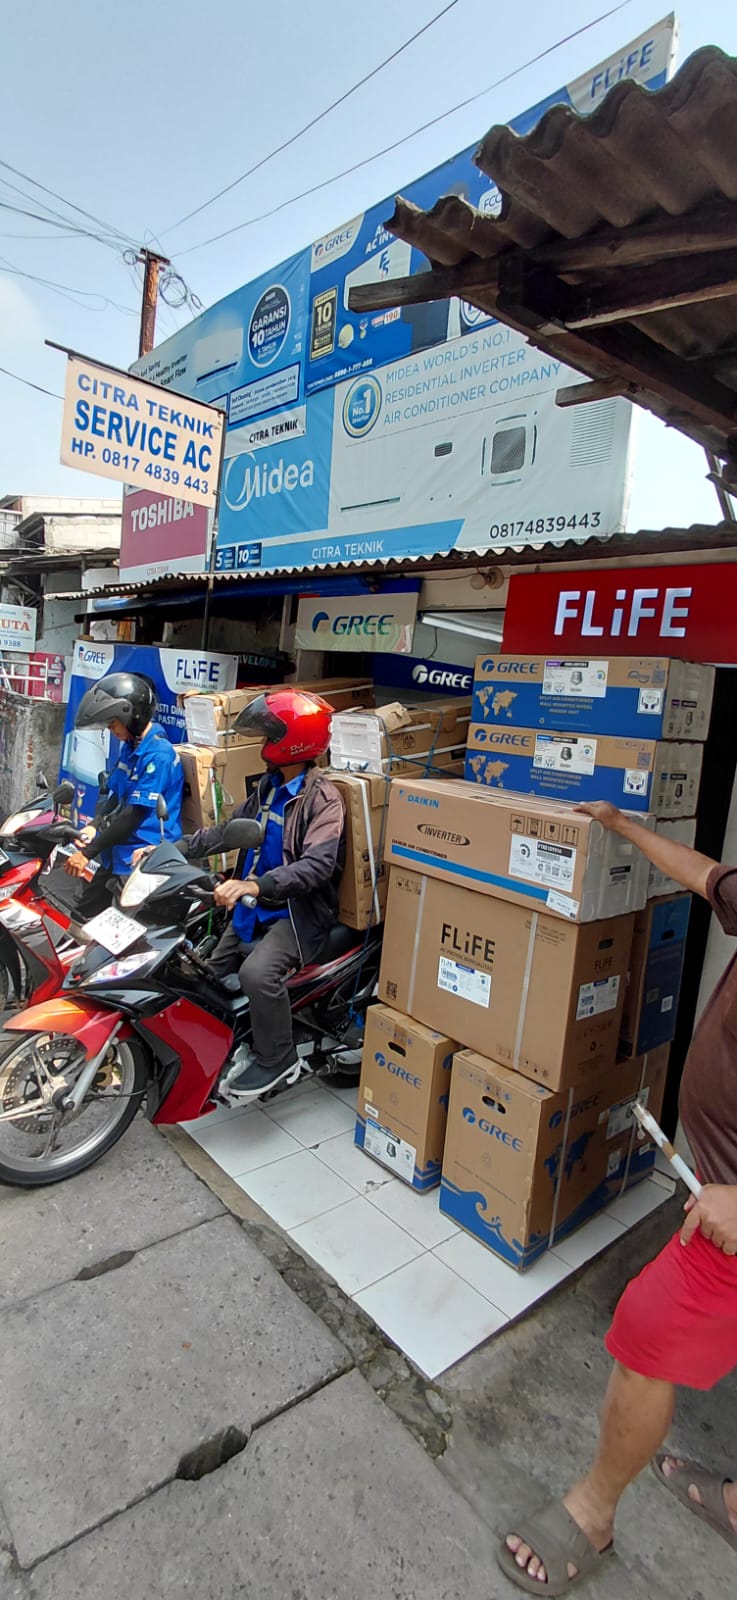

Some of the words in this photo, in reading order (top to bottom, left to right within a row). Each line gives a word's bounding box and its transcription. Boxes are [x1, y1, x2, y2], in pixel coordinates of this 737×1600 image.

[325, 226, 353, 251] GREE
[252, 305, 287, 332] GARANSI
[317, 302, 332, 325] 10
[252, 330, 264, 348] 10
[386, 362, 420, 384] MIDEA
[423, 340, 479, 369] WORLD'S
[482, 330, 511, 350] NO.1
[384, 374, 457, 405] RESIDENTIAL
[460, 348, 526, 378] INVERTER
[78, 374, 139, 411] CITRA
[146, 399, 214, 438] TEKNIK
[384, 410, 400, 425] AIR
[404, 384, 486, 420] CONDITIONER
[490, 362, 562, 393] COMPANY
[74, 400, 178, 460] SERVICE
[183, 440, 212, 472] AC
[248, 426, 270, 444] CITRA
[272, 418, 298, 436] TEKNIK
[72, 438, 96, 459] HP.
[102, 448, 140, 472] 0817
[144, 462, 179, 484] 4839
[184, 476, 208, 494] 443
[230, 456, 314, 505] Midea
[130, 498, 194, 532] TOSHIBA
[490, 512, 601, 538] 08174839443
[216, 552, 224, 568] 5
[238, 549, 249, 563] 10
[312, 546, 341, 560] CITRA
[344, 540, 384, 556] TEKNIK
[332, 614, 394, 635] GREE
[554, 587, 692, 637] FLiFE
[84, 650, 106, 664] GREE
[176, 658, 220, 682] FLiFE
[497, 662, 540, 674] GREE
[428, 670, 472, 689] GREE
[490, 732, 531, 747] GREE
[407, 794, 440, 808] DAIKIN
[424, 826, 462, 844] INVERTER
[416, 845, 447, 859] CONDITIONER
[441, 922, 495, 964] FLiFE
[387, 1062, 422, 1089] GREE
[478, 1118, 524, 1152] GREE
